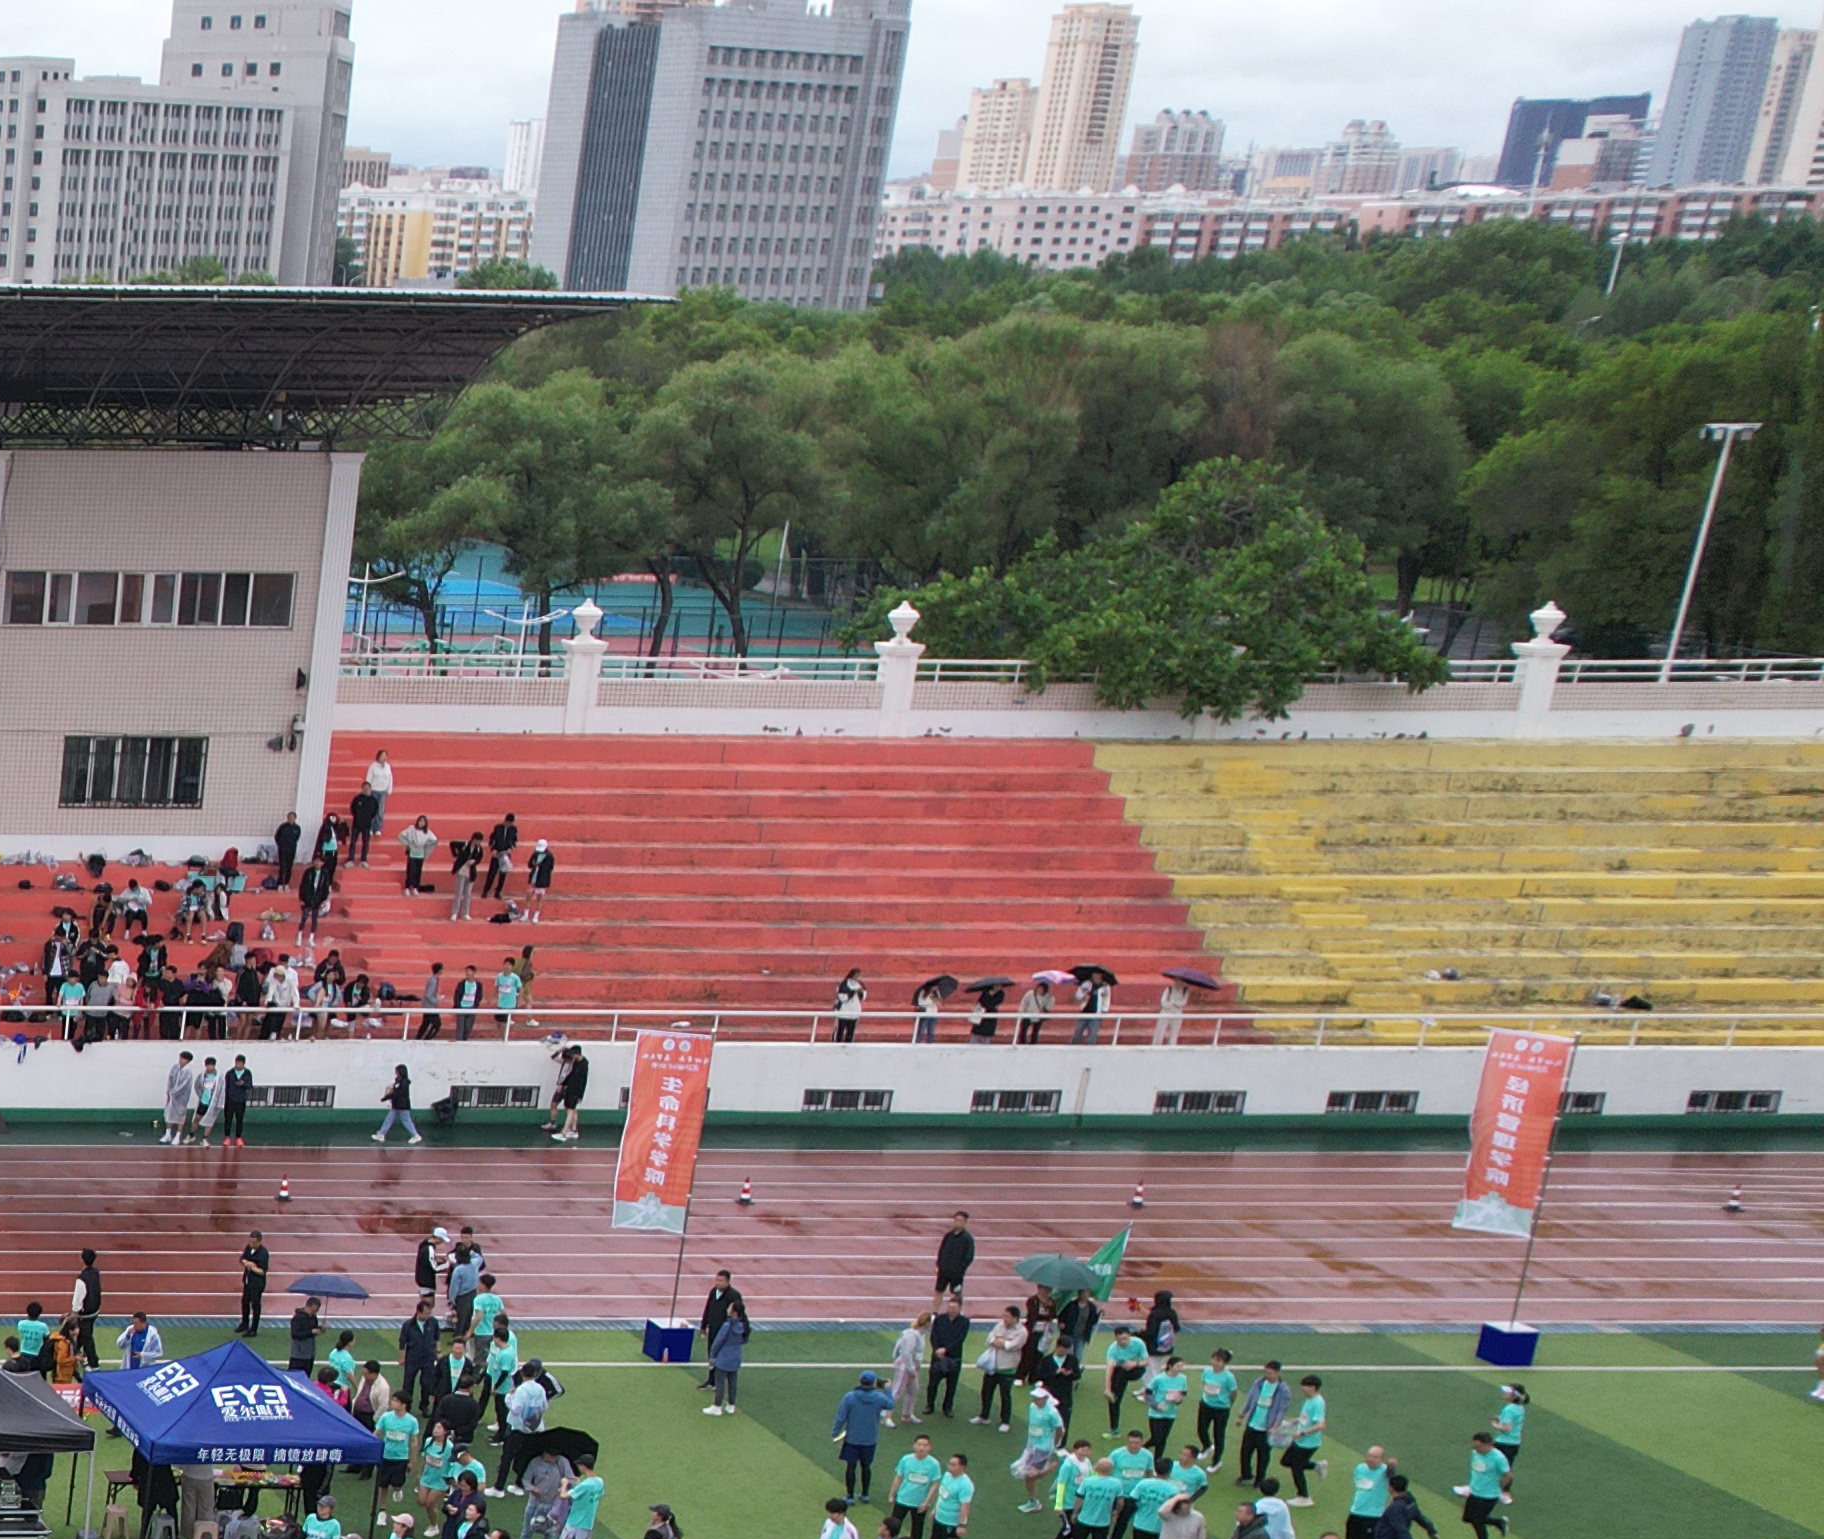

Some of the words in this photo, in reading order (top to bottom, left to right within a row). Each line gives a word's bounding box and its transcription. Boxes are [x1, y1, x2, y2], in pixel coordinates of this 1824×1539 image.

[221, 1404, 291, 1418] 爱尔眼科
[197, 1447, 265, 1462] 年轻无极限
